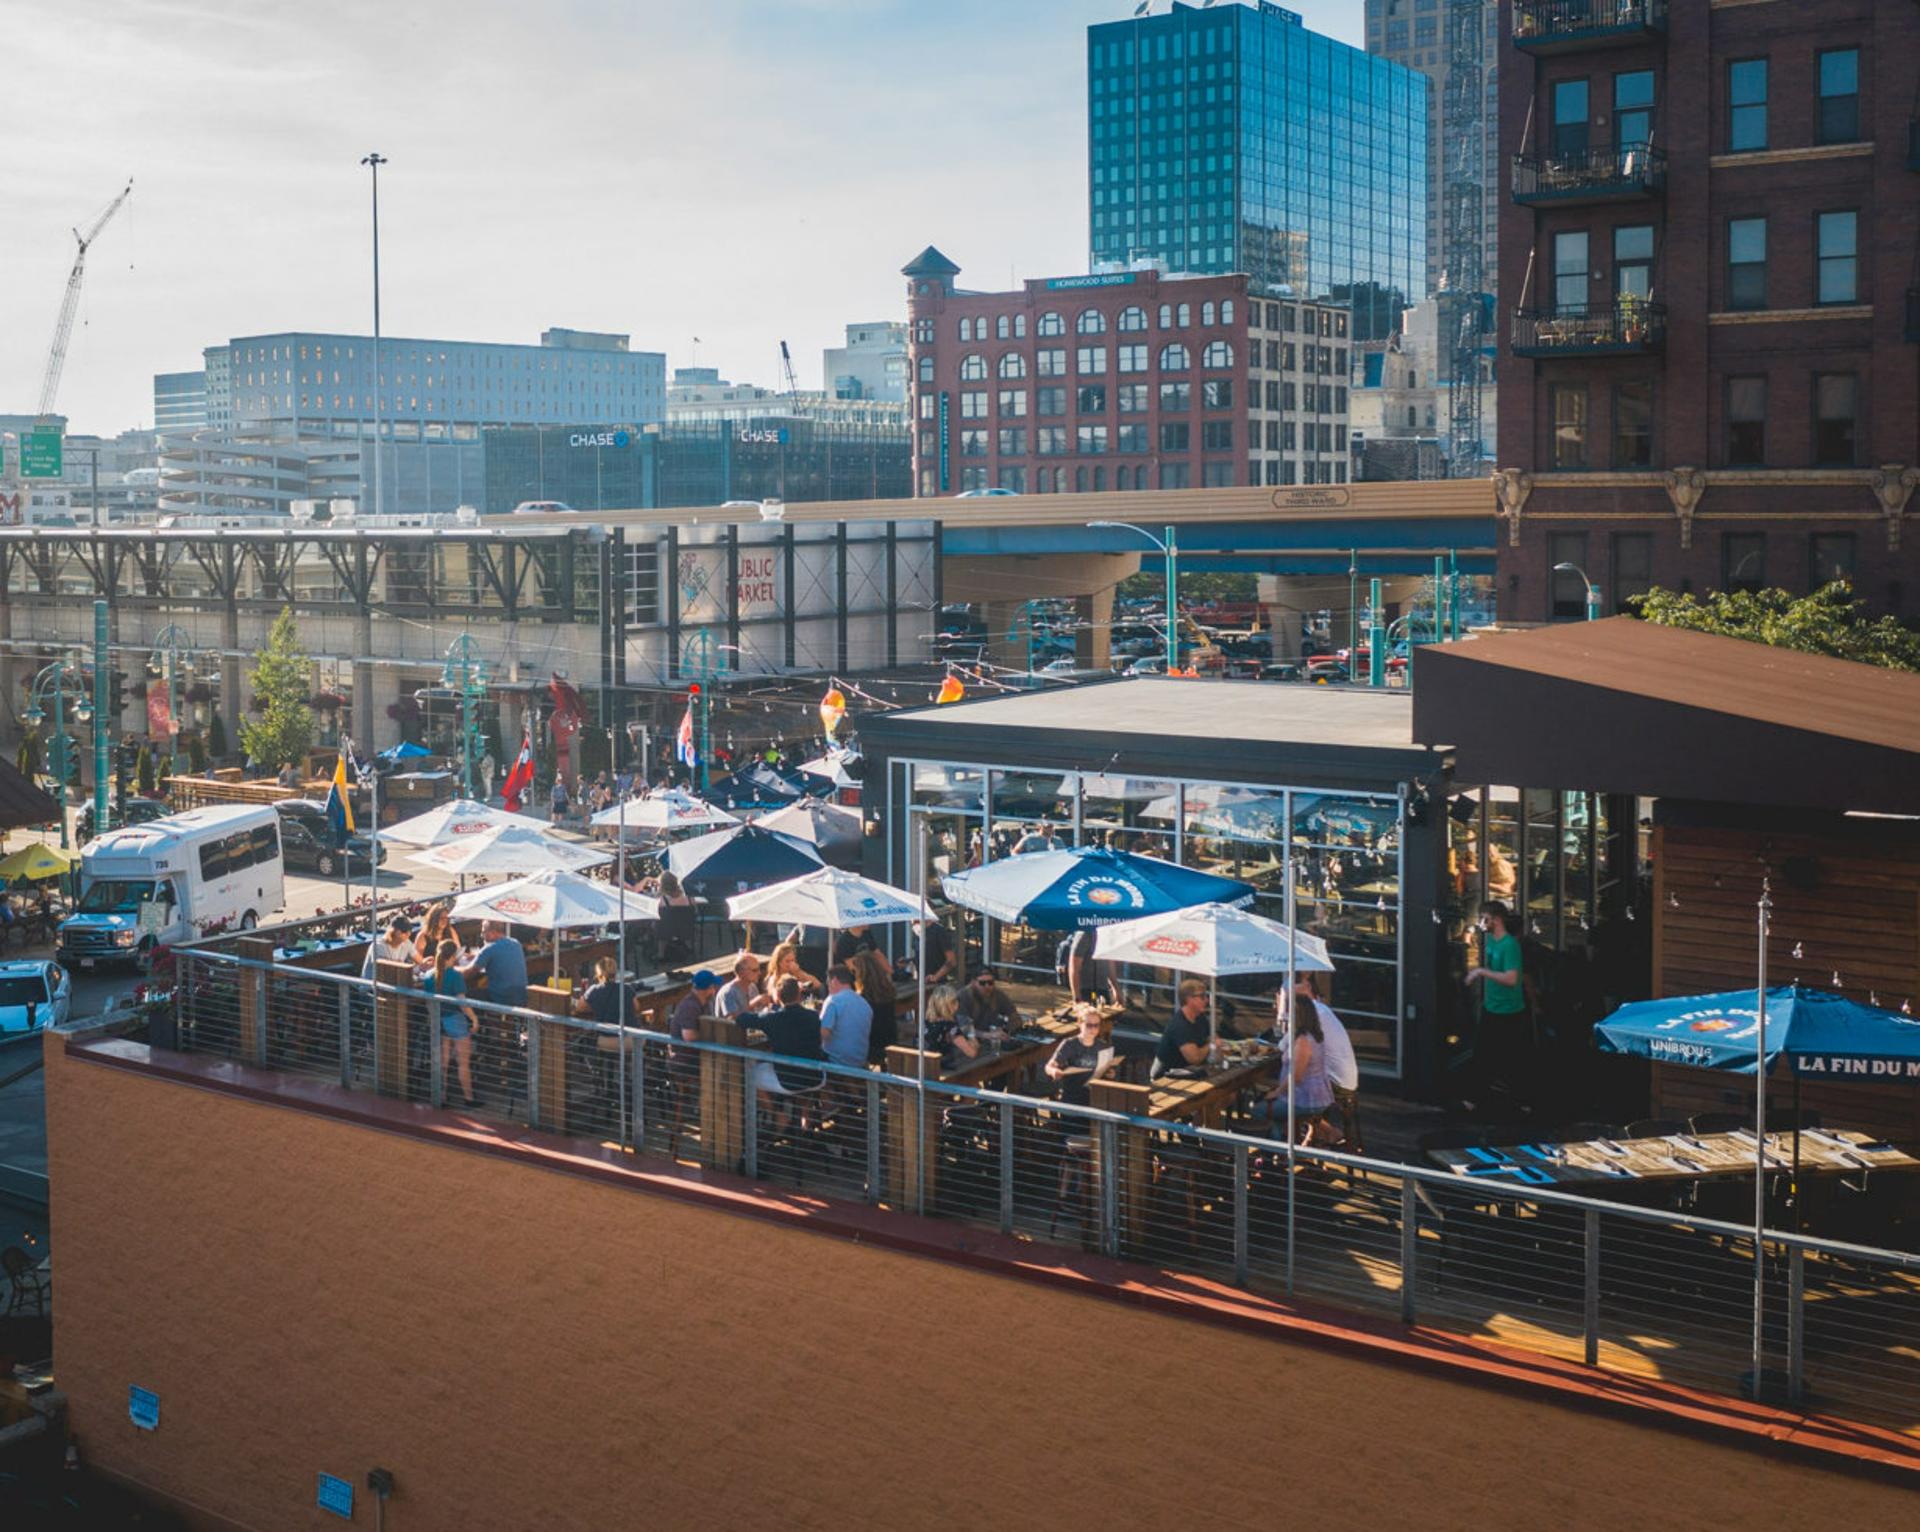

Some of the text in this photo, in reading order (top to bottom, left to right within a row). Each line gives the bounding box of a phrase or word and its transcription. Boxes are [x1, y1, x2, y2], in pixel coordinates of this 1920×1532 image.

[570, 433, 615, 447] CHASE
[741, 430, 779, 442] CHASE
[737, 558, 773, 578] UBLIC
[726, 583, 775, 602] ARKET
[1798, 1055, 1826, 1072] LA
[1830, 1057, 1868, 1074] FIN
[1871, 1060, 1901, 1076] DU
